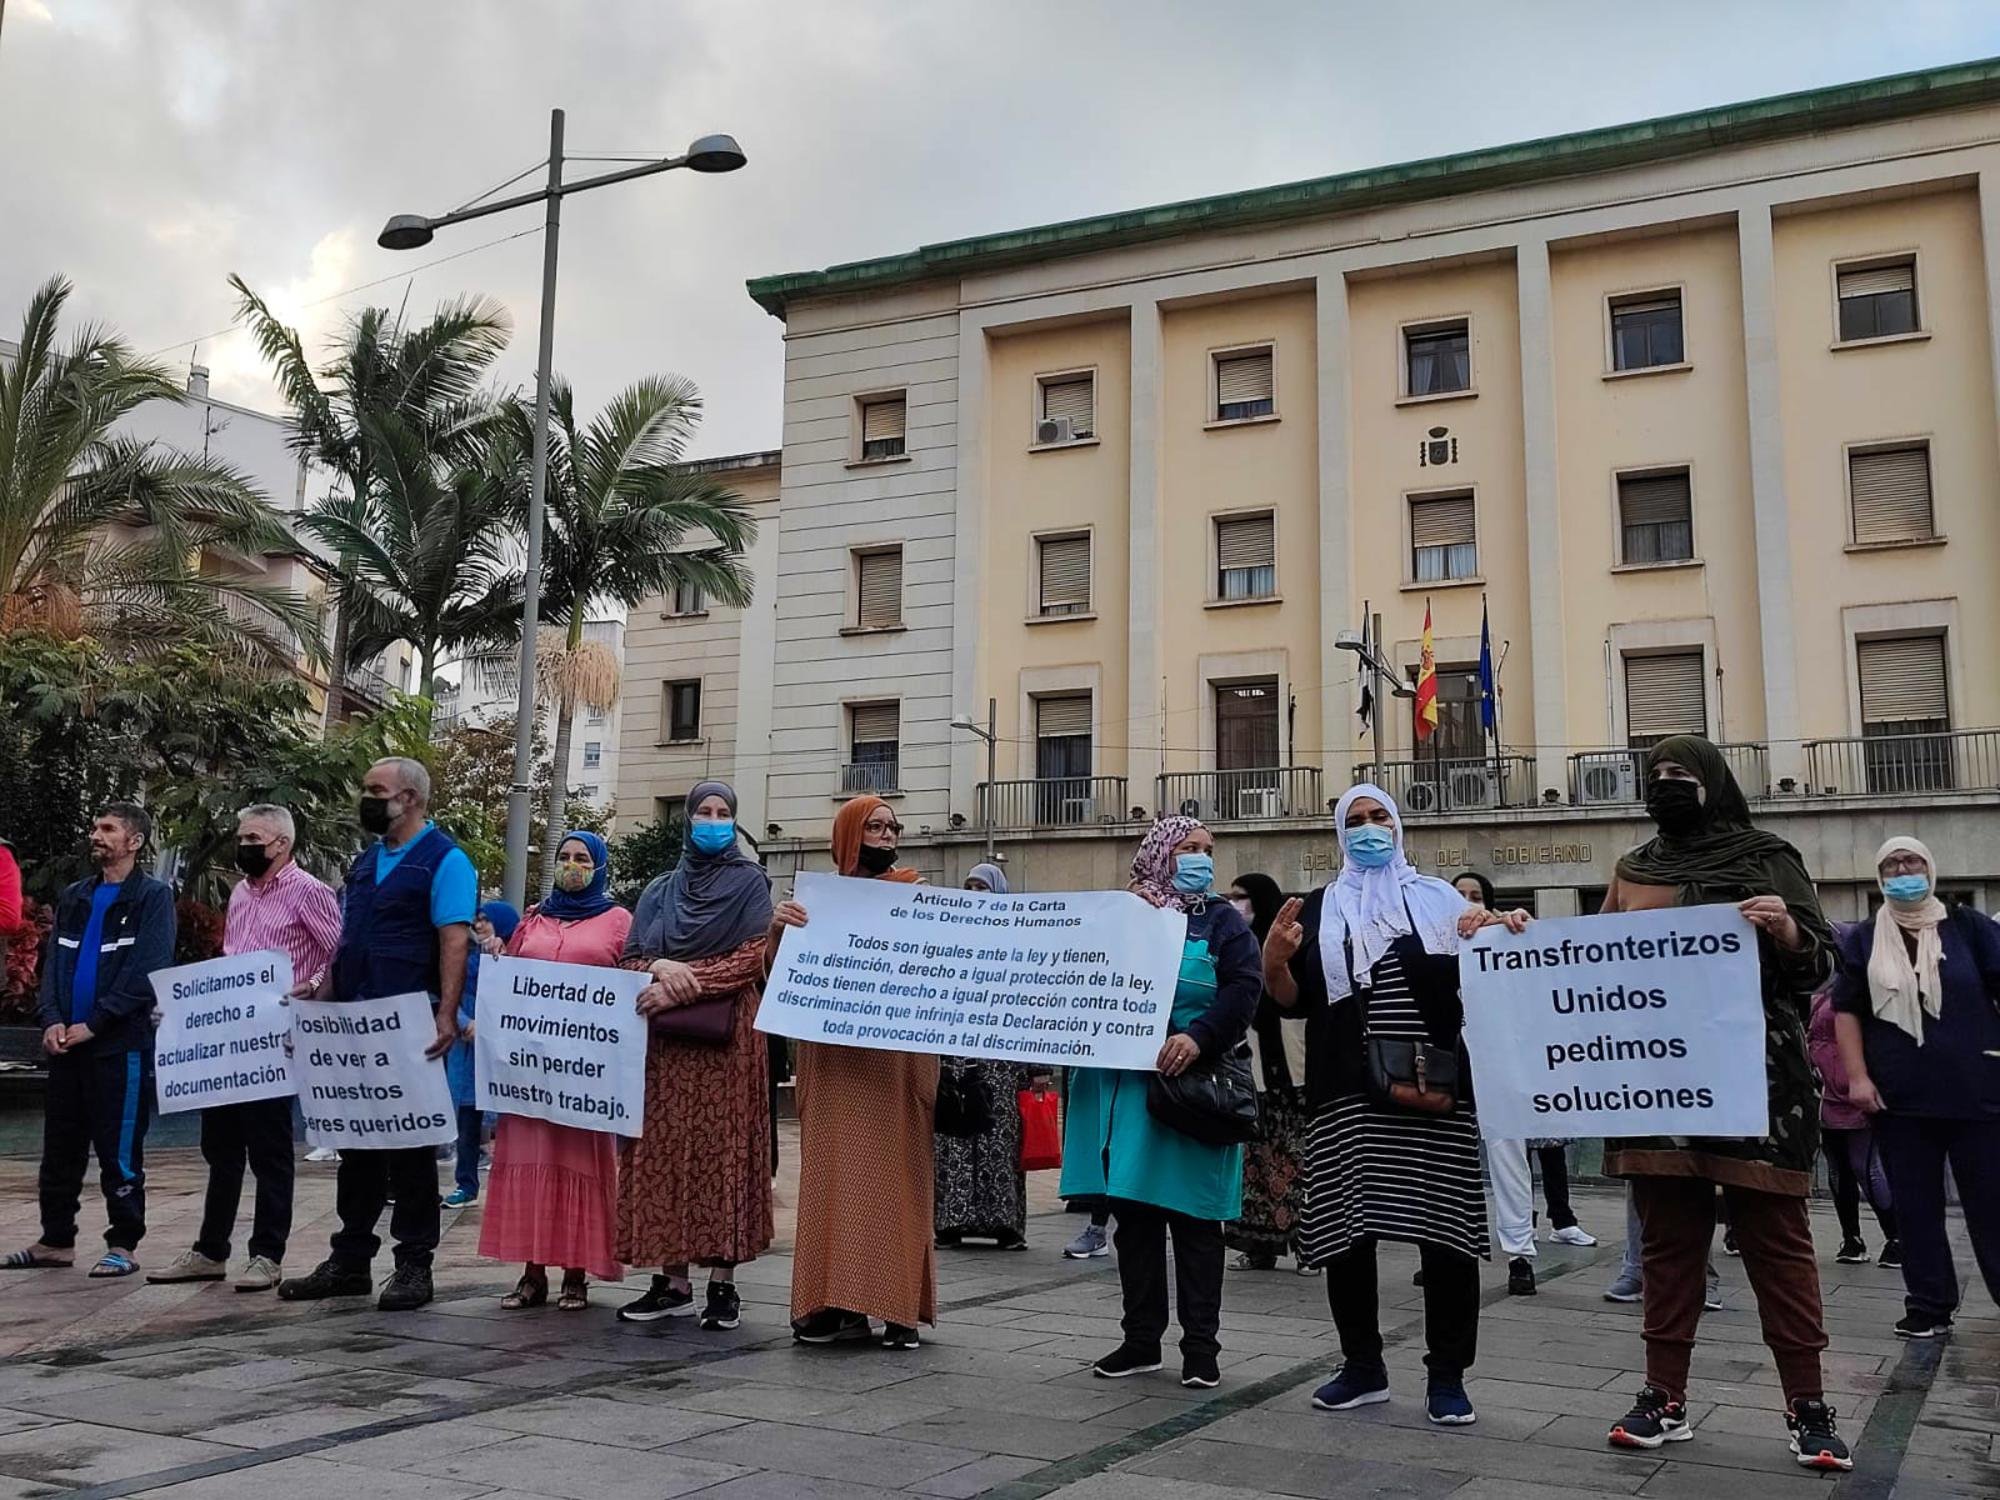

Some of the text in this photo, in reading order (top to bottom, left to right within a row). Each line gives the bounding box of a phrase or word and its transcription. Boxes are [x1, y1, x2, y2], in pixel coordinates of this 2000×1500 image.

[1437, 849, 1473, 866] DEL
[1492, 843, 1592, 865] GOBIERNO
[890, 906, 1082, 927] de los Derechos Humanos
[977, 900, 986, 910] 7
[990, 901, 1007, 911] de
[1011, 901, 1024, 912] la
[1028, 901, 1066, 911] Carta
[848, 933, 1110, 967] Todos son iguales ante la ley y tienen,
[1473, 931, 1741, 972] Transfronterizos
[173, 965, 275, 1001] Solicitamos el
[797, 951, 1155, 994] sin distinción, derecho a igual protección de la ley.
[513, 975, 616, 1006] Libertad de
[787, 968, 1157, 1014] Todos tienen derecho a igual protección contra toda
[1551, 985, 1668, 1015] Unidos
[185, 1004, 255, 1029] derecho a
[777, 989, 1154, 1037] discriminación que infrinja esta Declaración y contra
[500, 1014, 620, 1044] movimientos
[823, 1019, 1095, 1056] toda provocación a tal discriminación.
[158, 1031, 289, 1067] actualizar nuestr
[310, 1048, 389, 1067] de ver a
[509, 1048, 605, 1078] sin perder
[1546, 1034, 1688, 1070] pedimos
[165, 1064, 286, 1098] documentación
[312, 1081, 403, 1101] nuestros
[488, 1081, 630, 1120] nuestro trabajo.
[1533, 1083, 1714, 1114] soluciones
[350, 1112, 447, 1136] queridos
